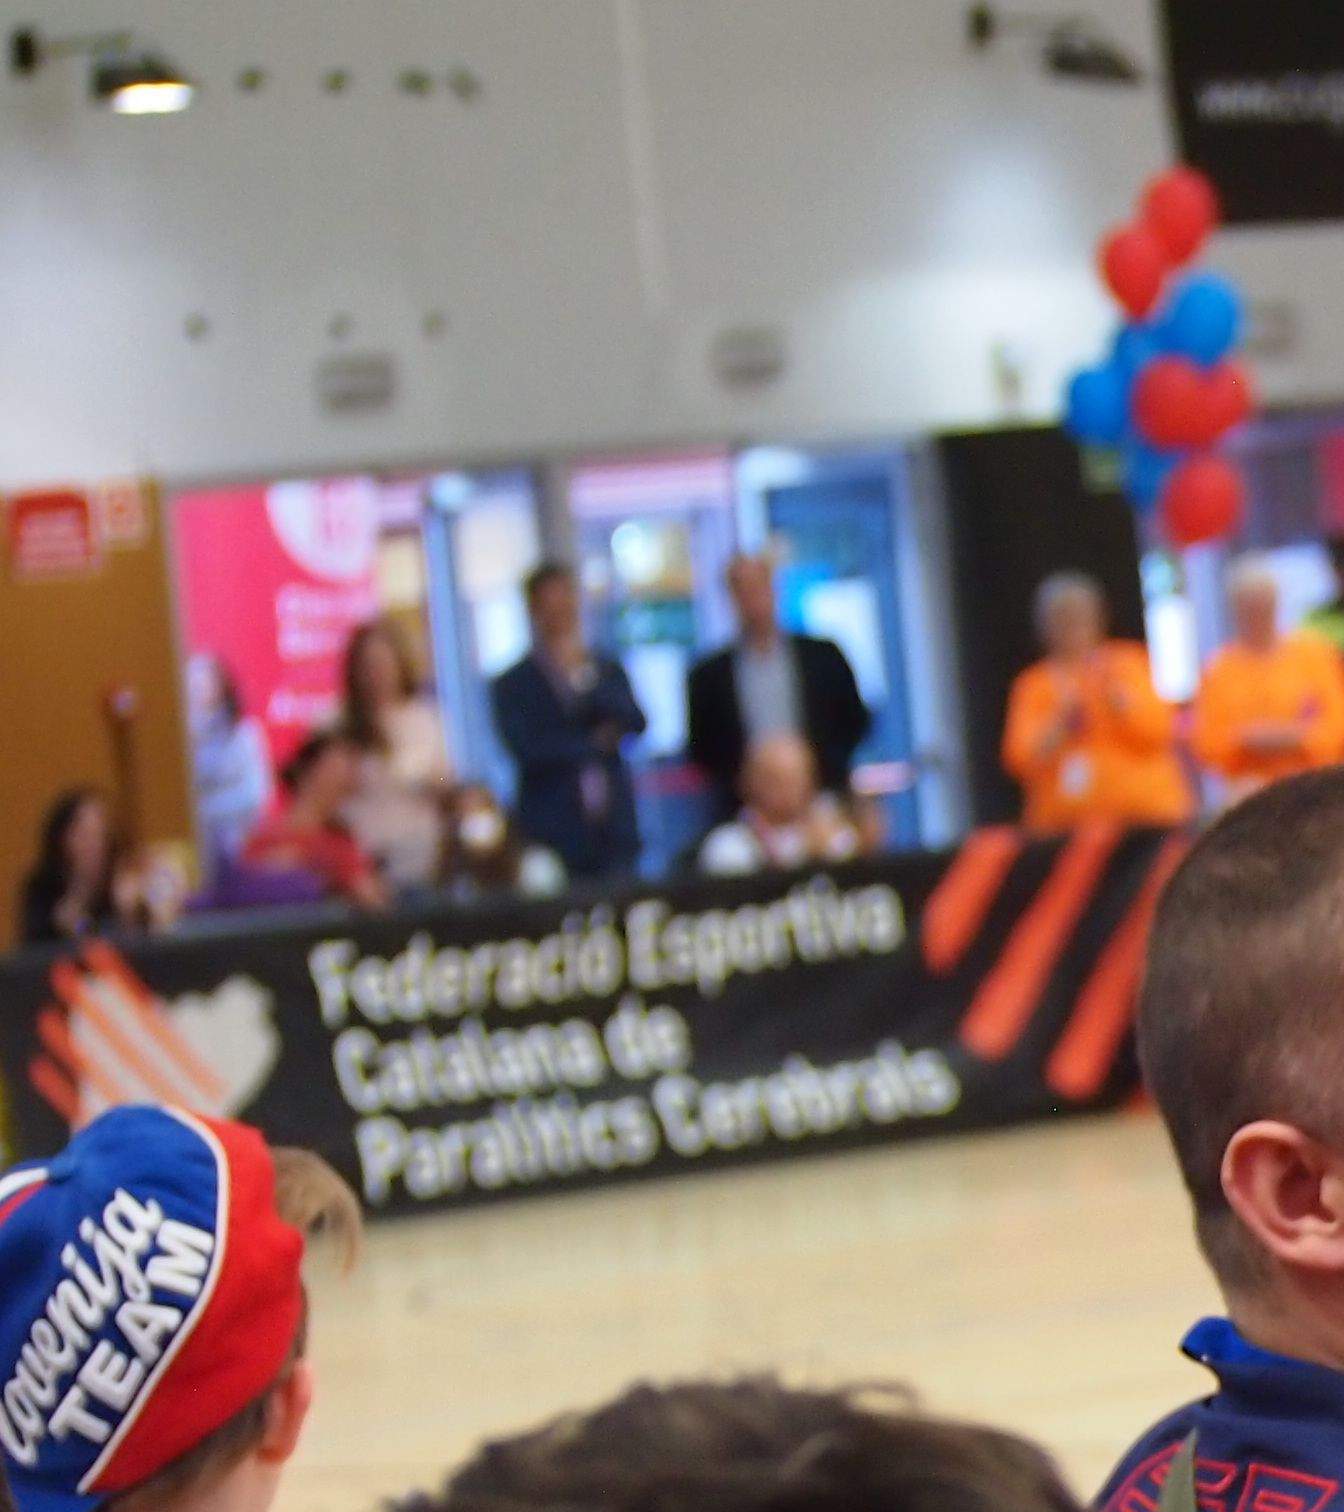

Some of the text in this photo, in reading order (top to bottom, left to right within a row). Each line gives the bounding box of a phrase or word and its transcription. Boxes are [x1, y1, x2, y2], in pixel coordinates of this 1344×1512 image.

[308, 874, 905, 1026] Federació Esportiva
[332, 995, 690, 1113] Catalana de
[652, 1038, 961, 1156] Cerebrals
[48, 1218, 215, 1442] TEAM
